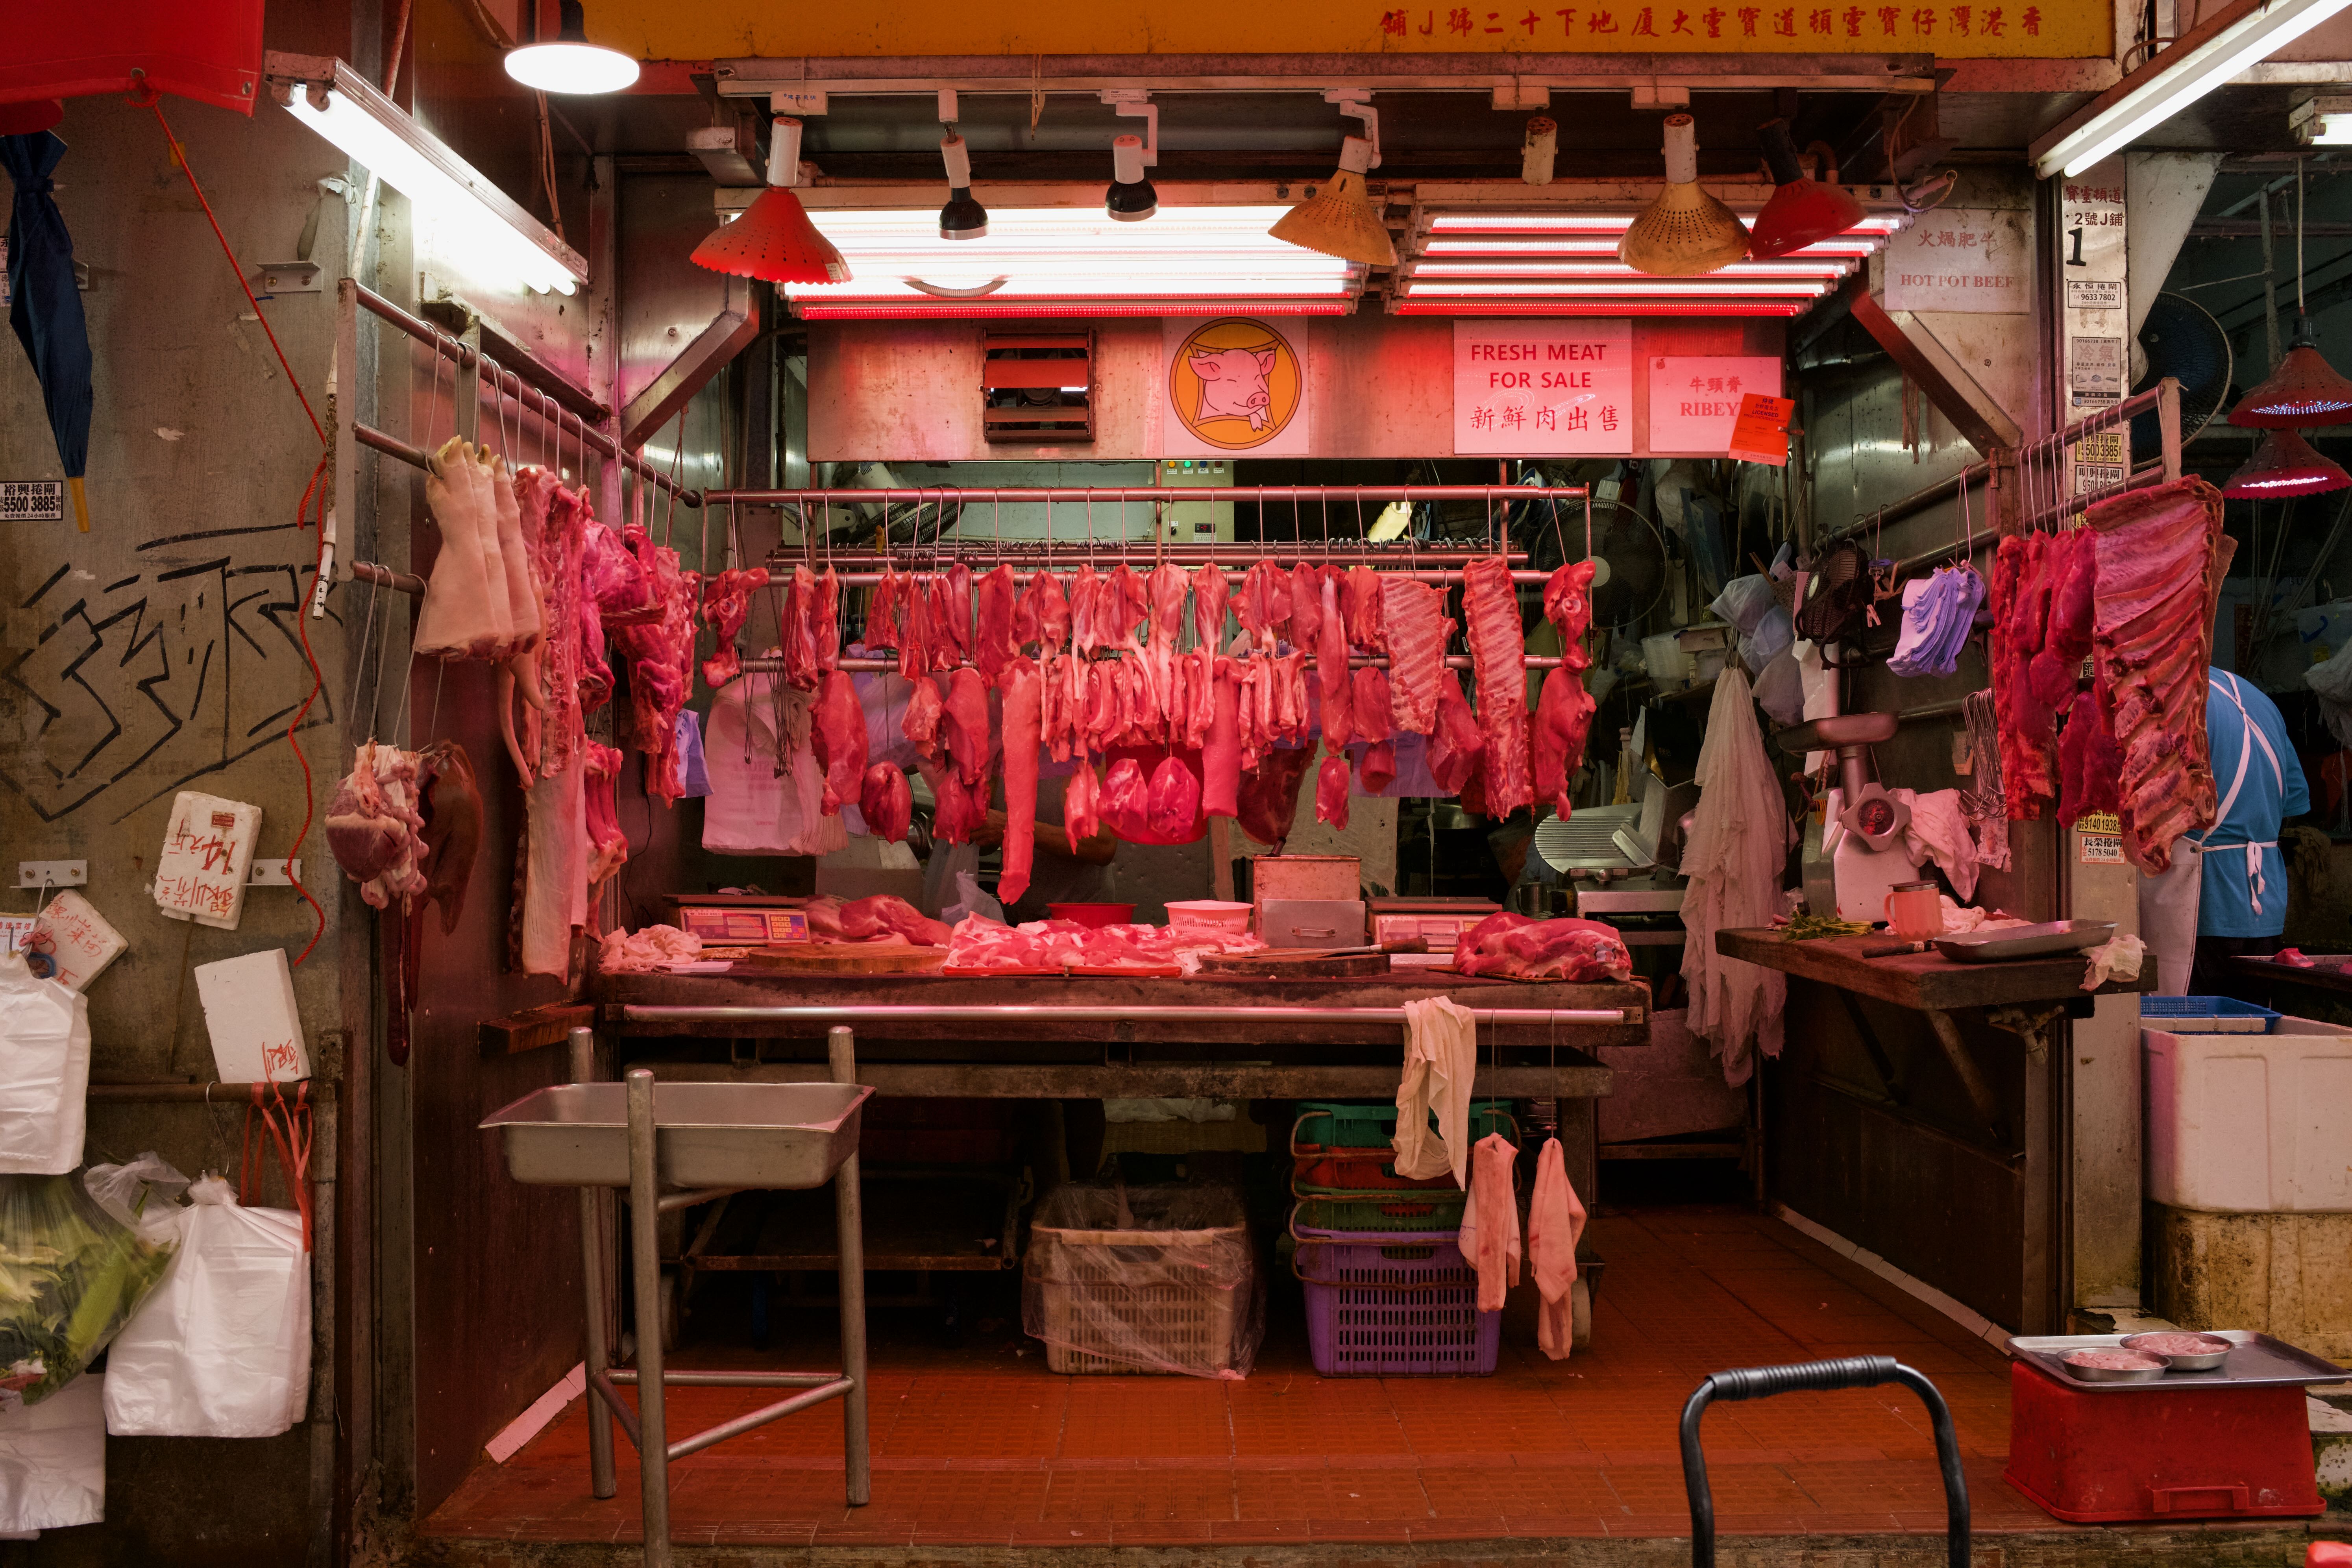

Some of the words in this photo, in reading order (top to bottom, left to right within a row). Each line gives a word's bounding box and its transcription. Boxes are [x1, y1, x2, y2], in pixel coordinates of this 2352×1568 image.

[1901, 274, 1934, 287] HOT
[1940, 276, 1970, 287] POT
[1974, 276, 2014, 288] BEEF
[1471, 344, 1537, 361] FRESH
[1548, 344, 1607, 361] MEAT
[2078, 345, 2115, 362] 冷氣
[1490, 372, 1531, 388] FOR
[1541, 371, 1592, 388] SALE
[1680, 401, 1742, 417] RIBEY
[1752, 409, 1779, 418] LICENSED
[1470, 405, 1620, 433] 新鮮肉出售
[4, 483, 56, 496] 裕興捲閘
[4, 496, 29, 512] 5500
[31, 495, 56, 512] 3885
[2102, 818, 2117, 831] 1938
[2084, 837, 2122, 847] 長榮捲閘
[2088, 848, 2102, 856] 5178
[2103, 849, 2117, 857] 5040
